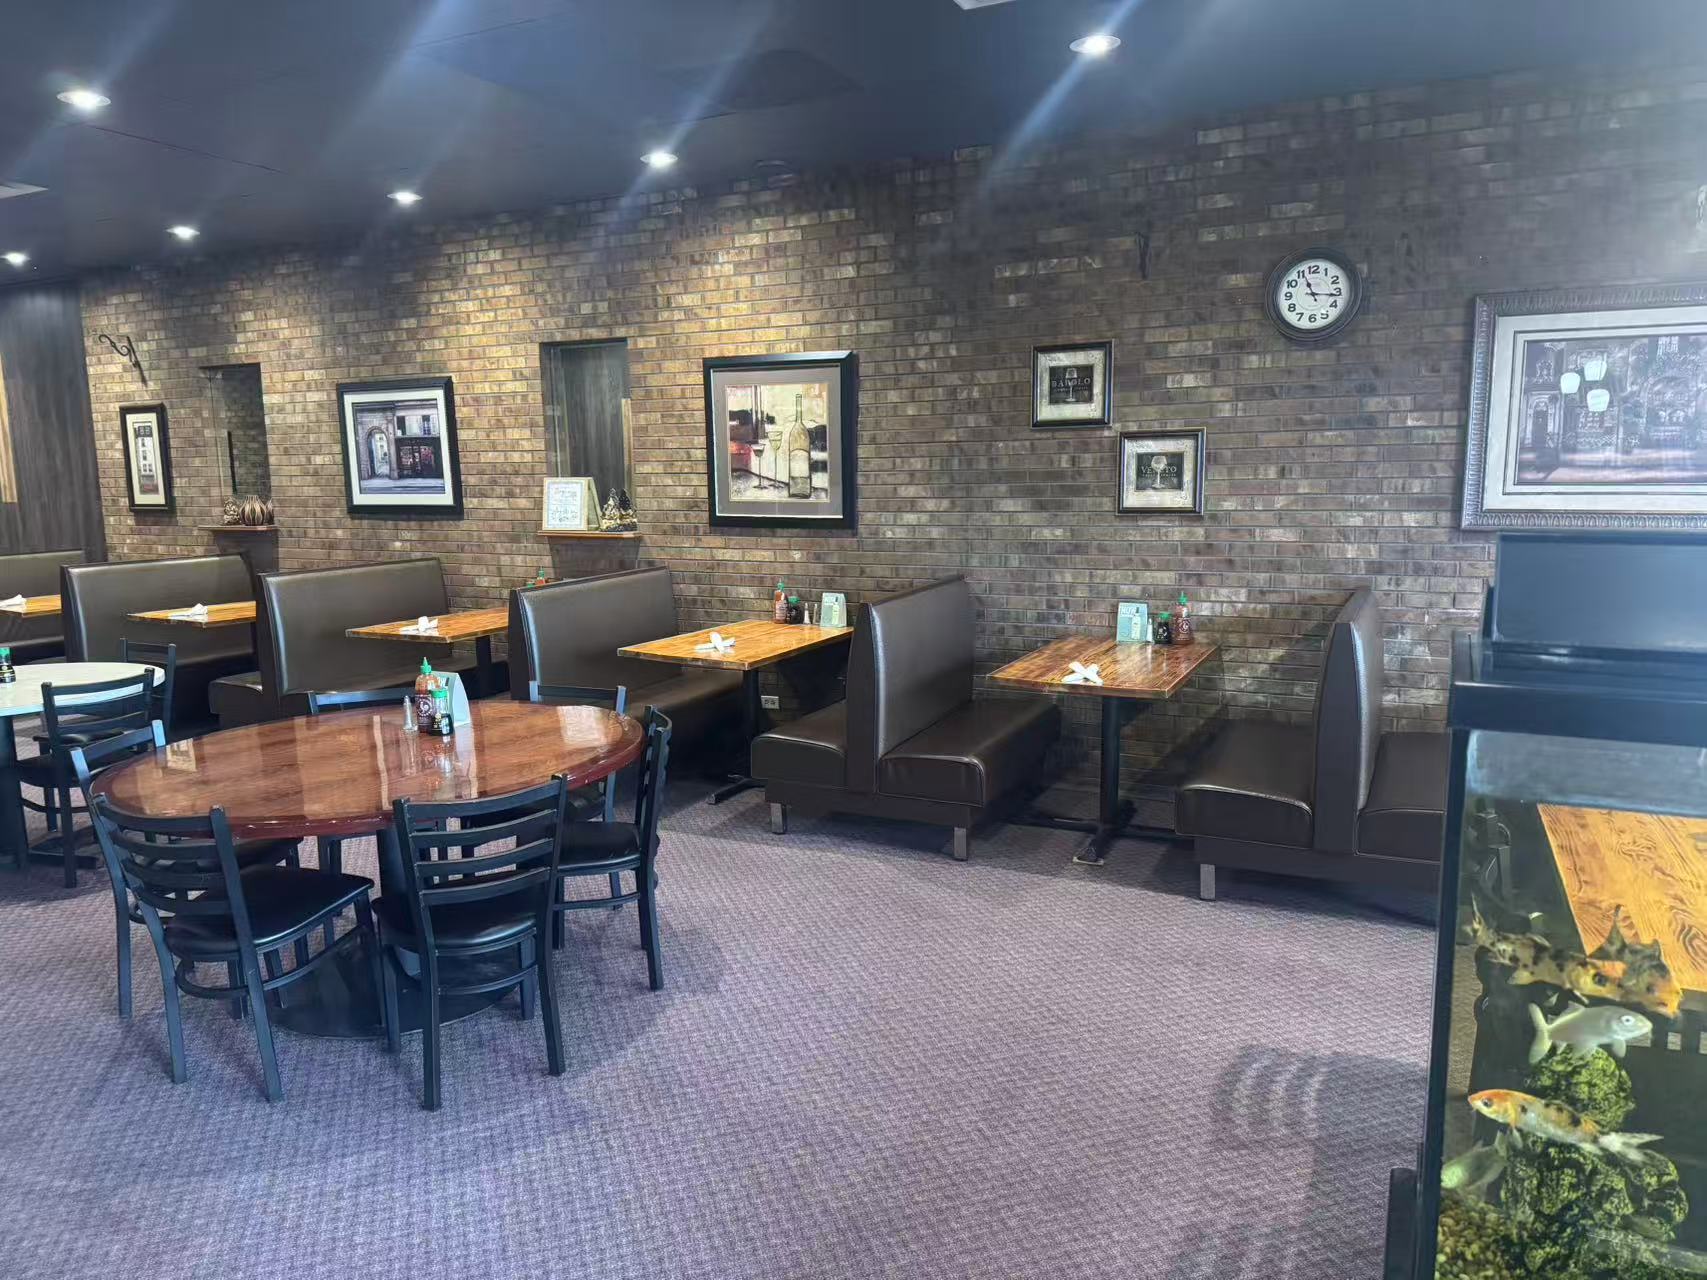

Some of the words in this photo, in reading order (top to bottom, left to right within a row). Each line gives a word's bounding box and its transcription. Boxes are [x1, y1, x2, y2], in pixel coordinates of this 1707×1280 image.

[1296, 269, 1305, 279] 11
[1307, 265, 1320, 275] 12
[1323, 267, 1328, 276] 1
[1286, 279, 1298, 289] 10
[1330, 275, 1339, 285] 2
[1284, 291, 1293, 301] 9
[1333, 287, 1342, 296] 3
[1287, 303, 1296, 312] 8
[1329, 300, 1338, 309] 4
[1296, 312, 1304, 322] 7
[1308, 313, 1317, 323] 6
[1320, 310, 1329, 319] 5
[1141, 465, 1177, 474] VETO
